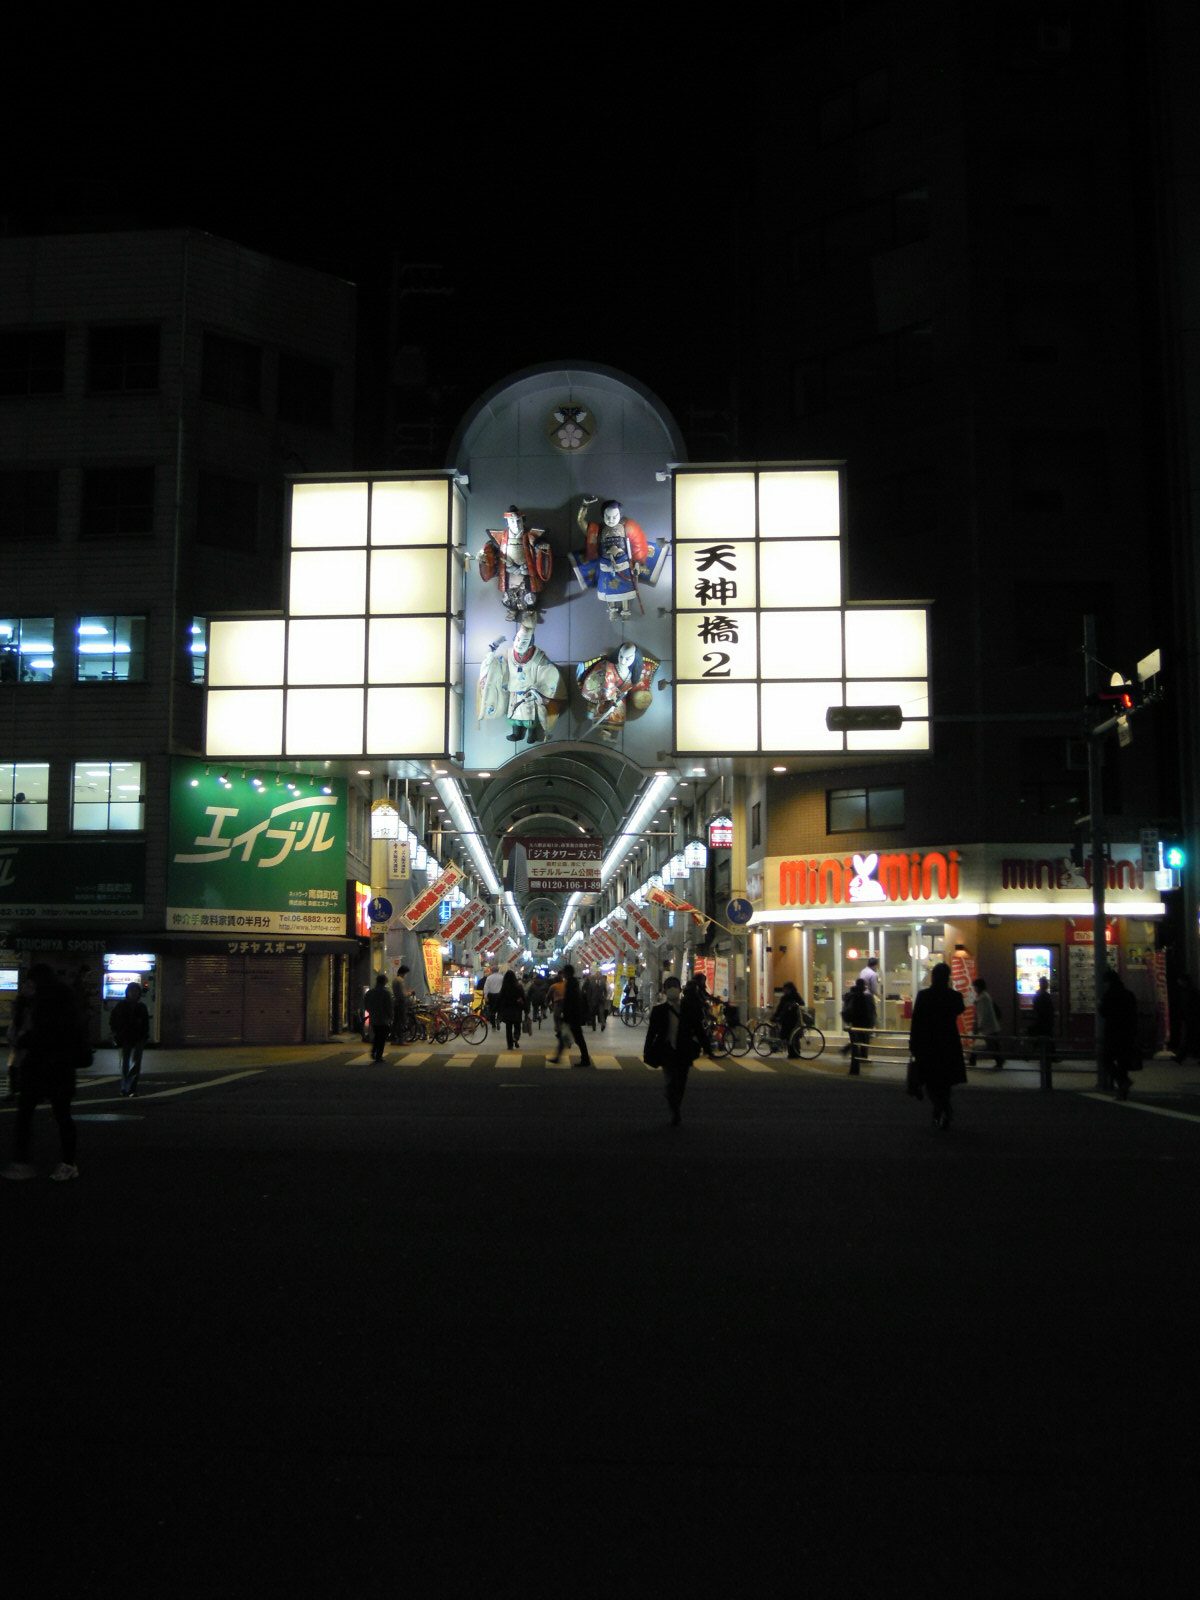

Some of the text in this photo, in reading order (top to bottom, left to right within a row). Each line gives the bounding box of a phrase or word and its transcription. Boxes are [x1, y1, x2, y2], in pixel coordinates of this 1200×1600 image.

[694, 544, 739, 678] 天神橋2
[173, 795, 339, 869] エイブル
[878, 850, 959, 902] mini
[172, 913, 271, 928] 仲介手数料家賃の半月分
